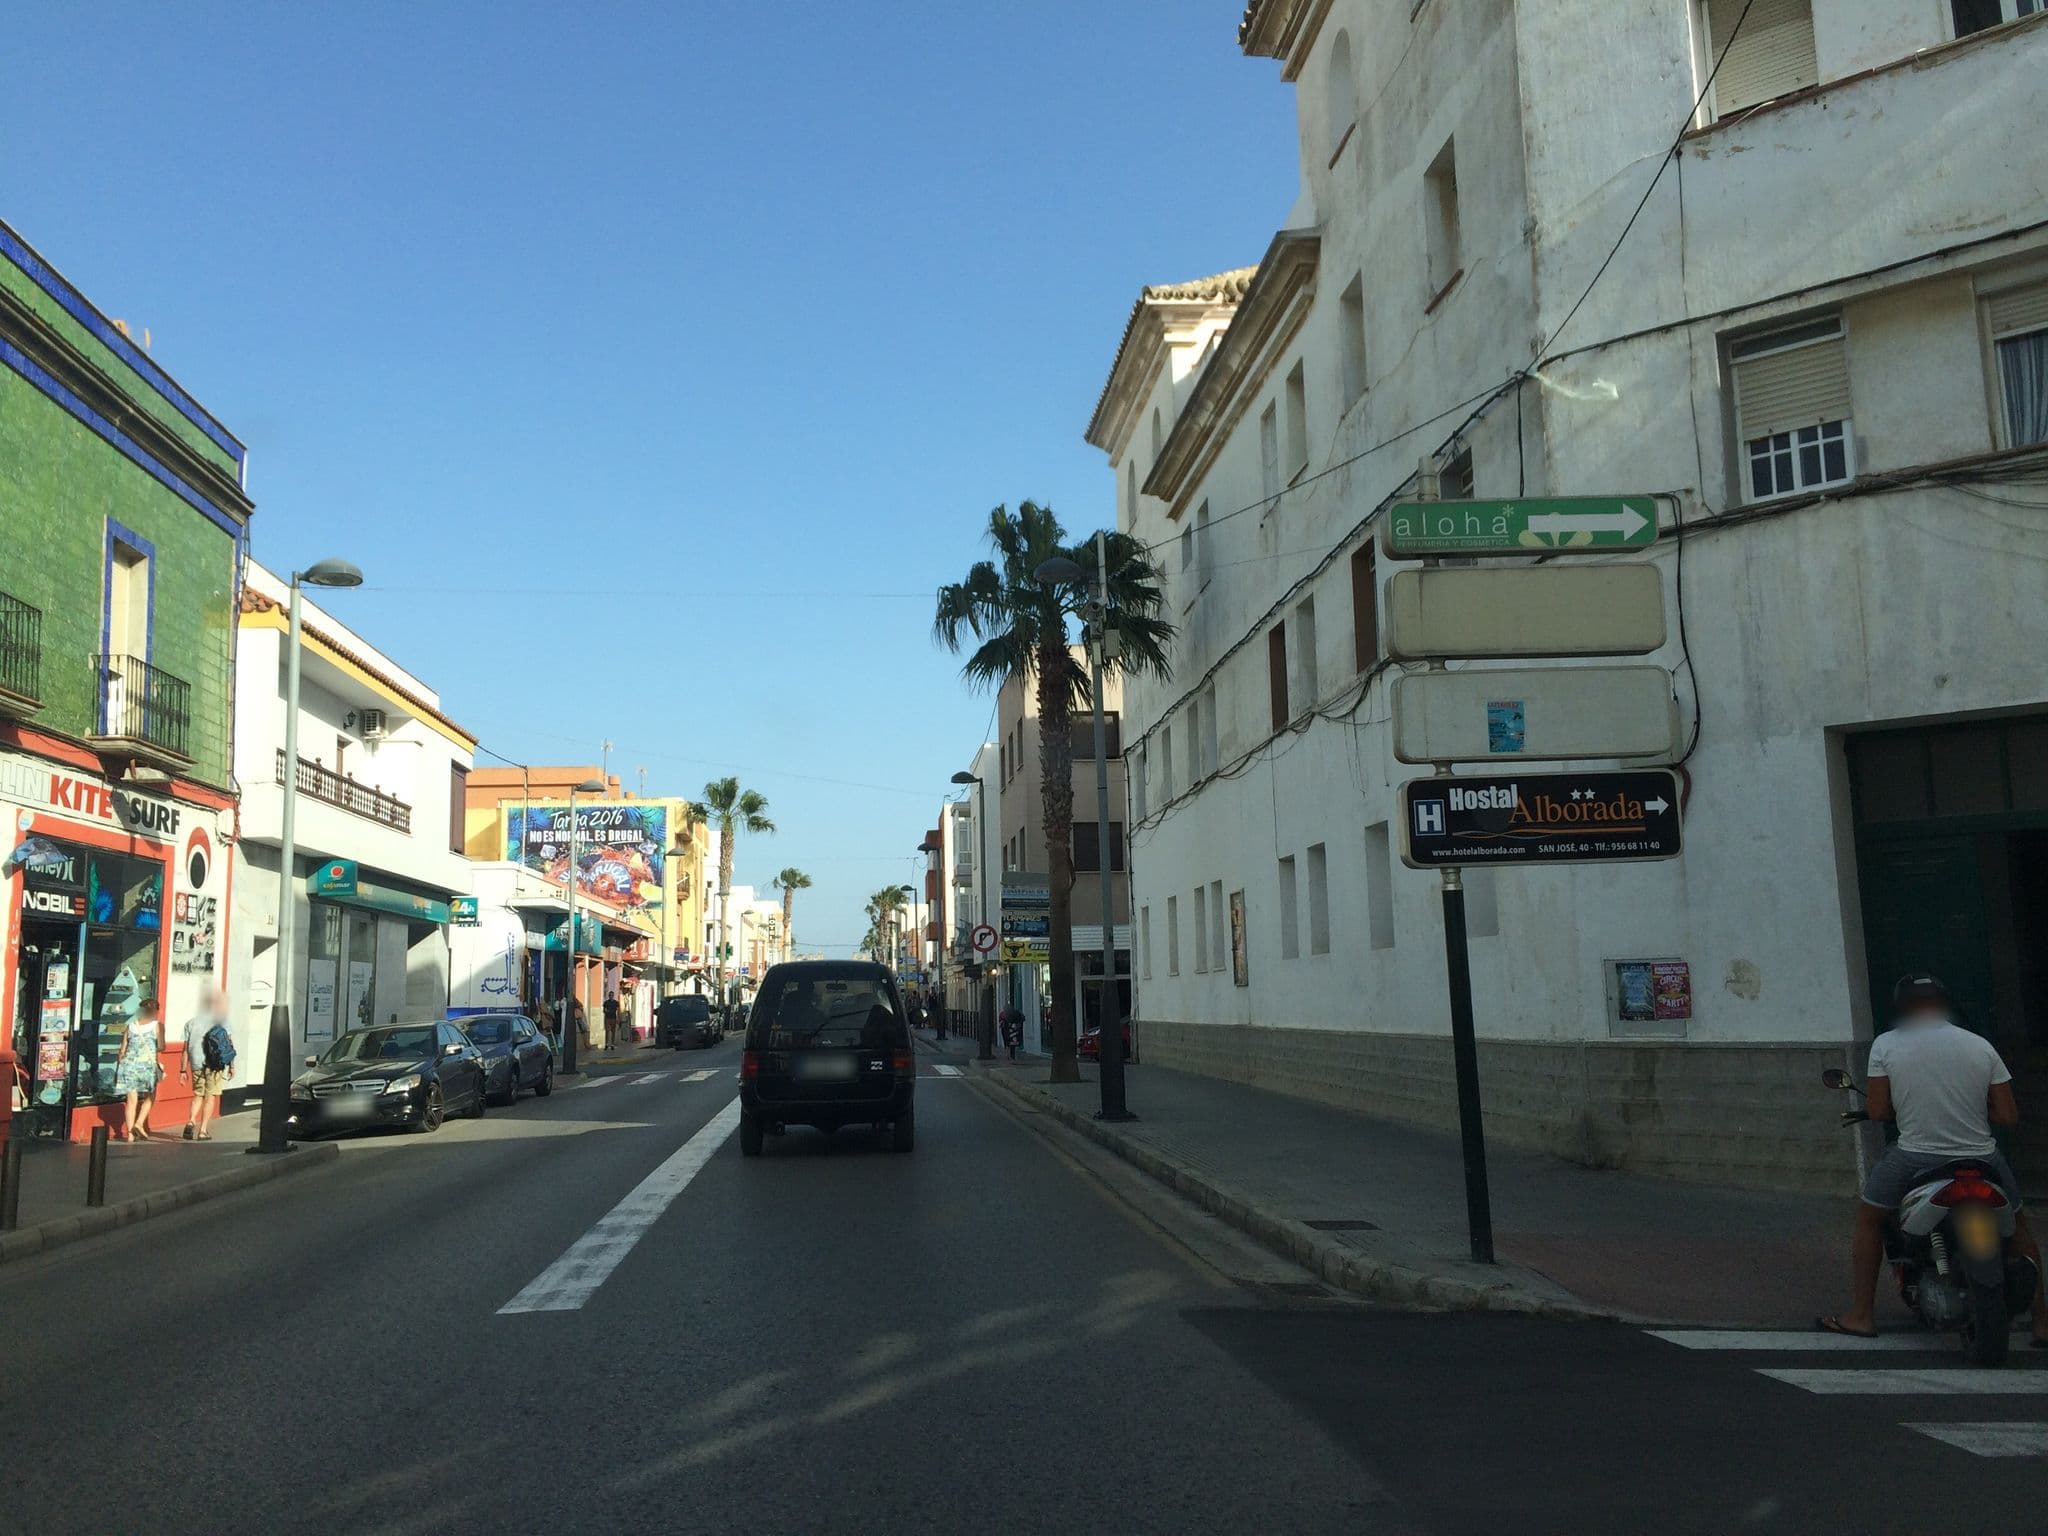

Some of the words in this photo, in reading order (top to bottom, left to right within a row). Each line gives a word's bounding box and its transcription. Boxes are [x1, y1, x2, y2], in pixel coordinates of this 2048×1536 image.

[1396, 511, 1508, 536] aloha
[0, 759, 49, 804] LINI
[50, 773, 114, 820] KITE
[129, 797, 181, 835] SURF
[1449, 784, 1518, 811] Hostal
[1508, 792, 1645, 824] Alborada
[551, 811, 588, 829] Tarfa
[589, 809, 625, 826] 2016
[1419, 803, 1443, 833] H
[530, 830, 542, 842] NO
[543, 830, 554, 842] ES
[594, 830, 606, 841] ES
[1538, 844, 1555, 853] SAN
[1579, 843, 1589, 852] 40
[1611, 842, 1626, 851] 956
[1627, 842, 1638, 850] 68
[1640, 841, 1648, 849] 11
[1650, 841, 1661, 849] 40
[1432, 846, 1526, 857] www.hotelalborada.com
